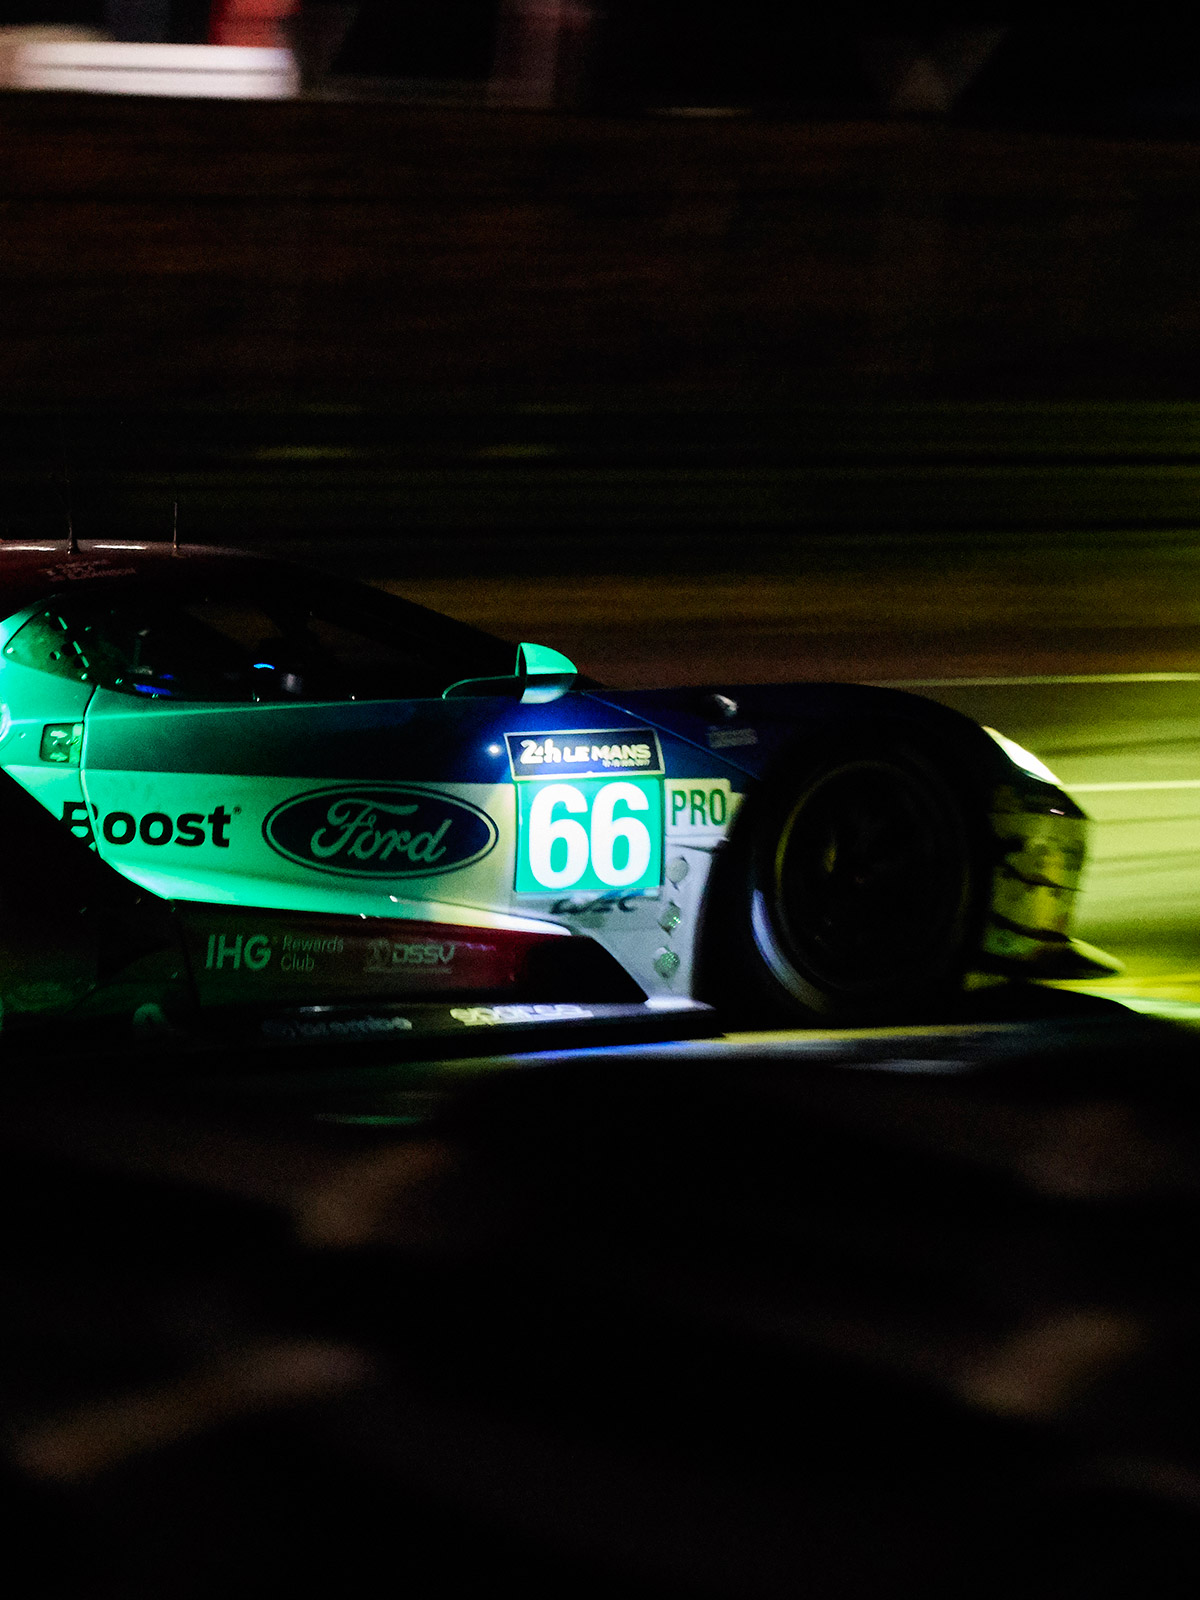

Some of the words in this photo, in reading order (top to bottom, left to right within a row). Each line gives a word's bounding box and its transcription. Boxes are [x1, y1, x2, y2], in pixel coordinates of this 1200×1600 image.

[563, 746, 590, 763] LE
[591, 743, 651, 762] MANS
[672, 788, 727, 826] PRO
[310, 798, 453, 863] Ford
[528, 781, 651, 890] 66
[204, 933, 272, 970] IHG
[280, 953, 315, 971] Club
[283, 935, 344, 953] Rewards
